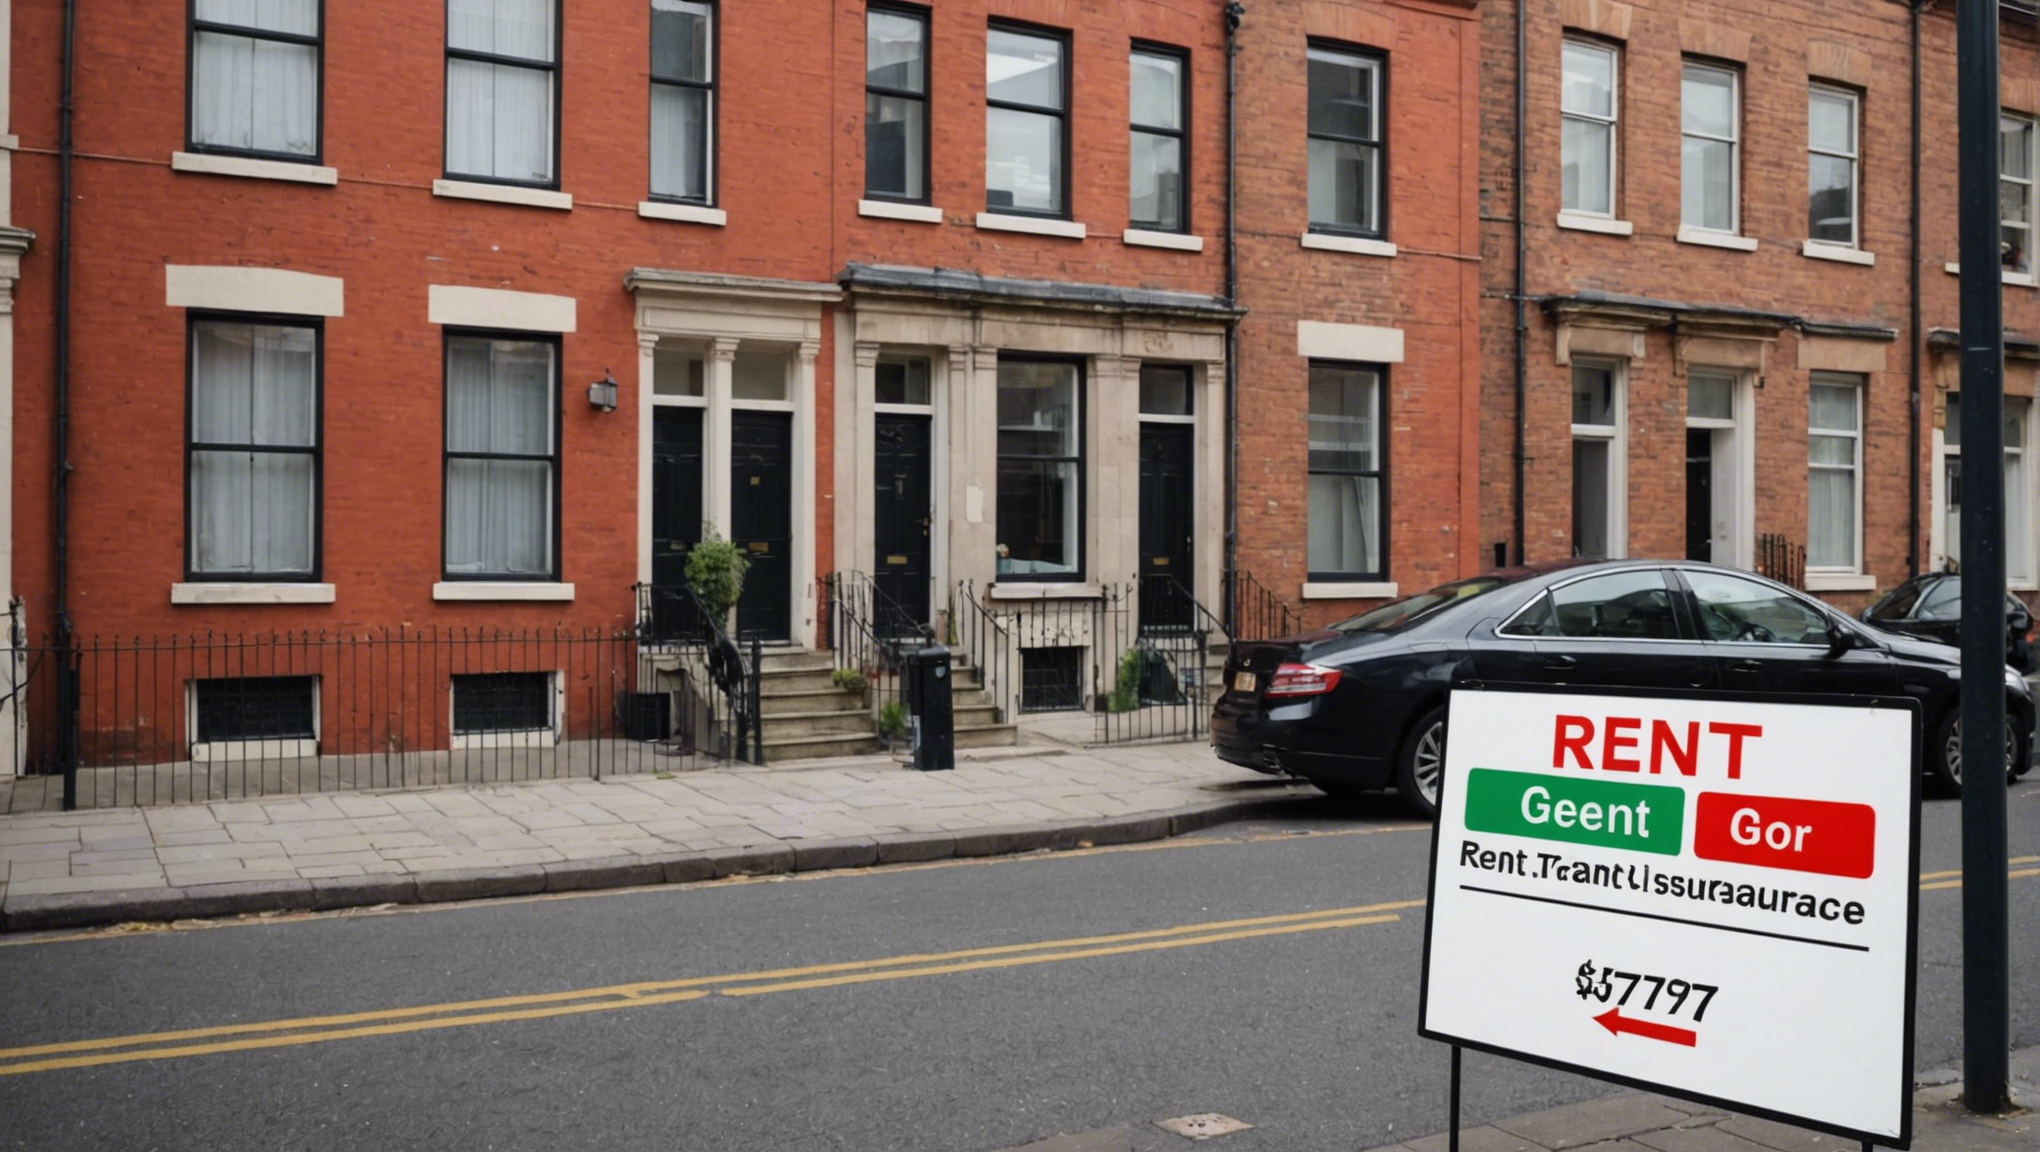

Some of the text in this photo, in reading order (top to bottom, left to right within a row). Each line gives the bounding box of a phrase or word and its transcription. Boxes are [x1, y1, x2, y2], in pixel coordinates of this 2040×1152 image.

[1552, 714, 1763, 780] RENT
[1520, 785, 1651, 838] Geent
[1729, 807, 1813, 852] Gor
